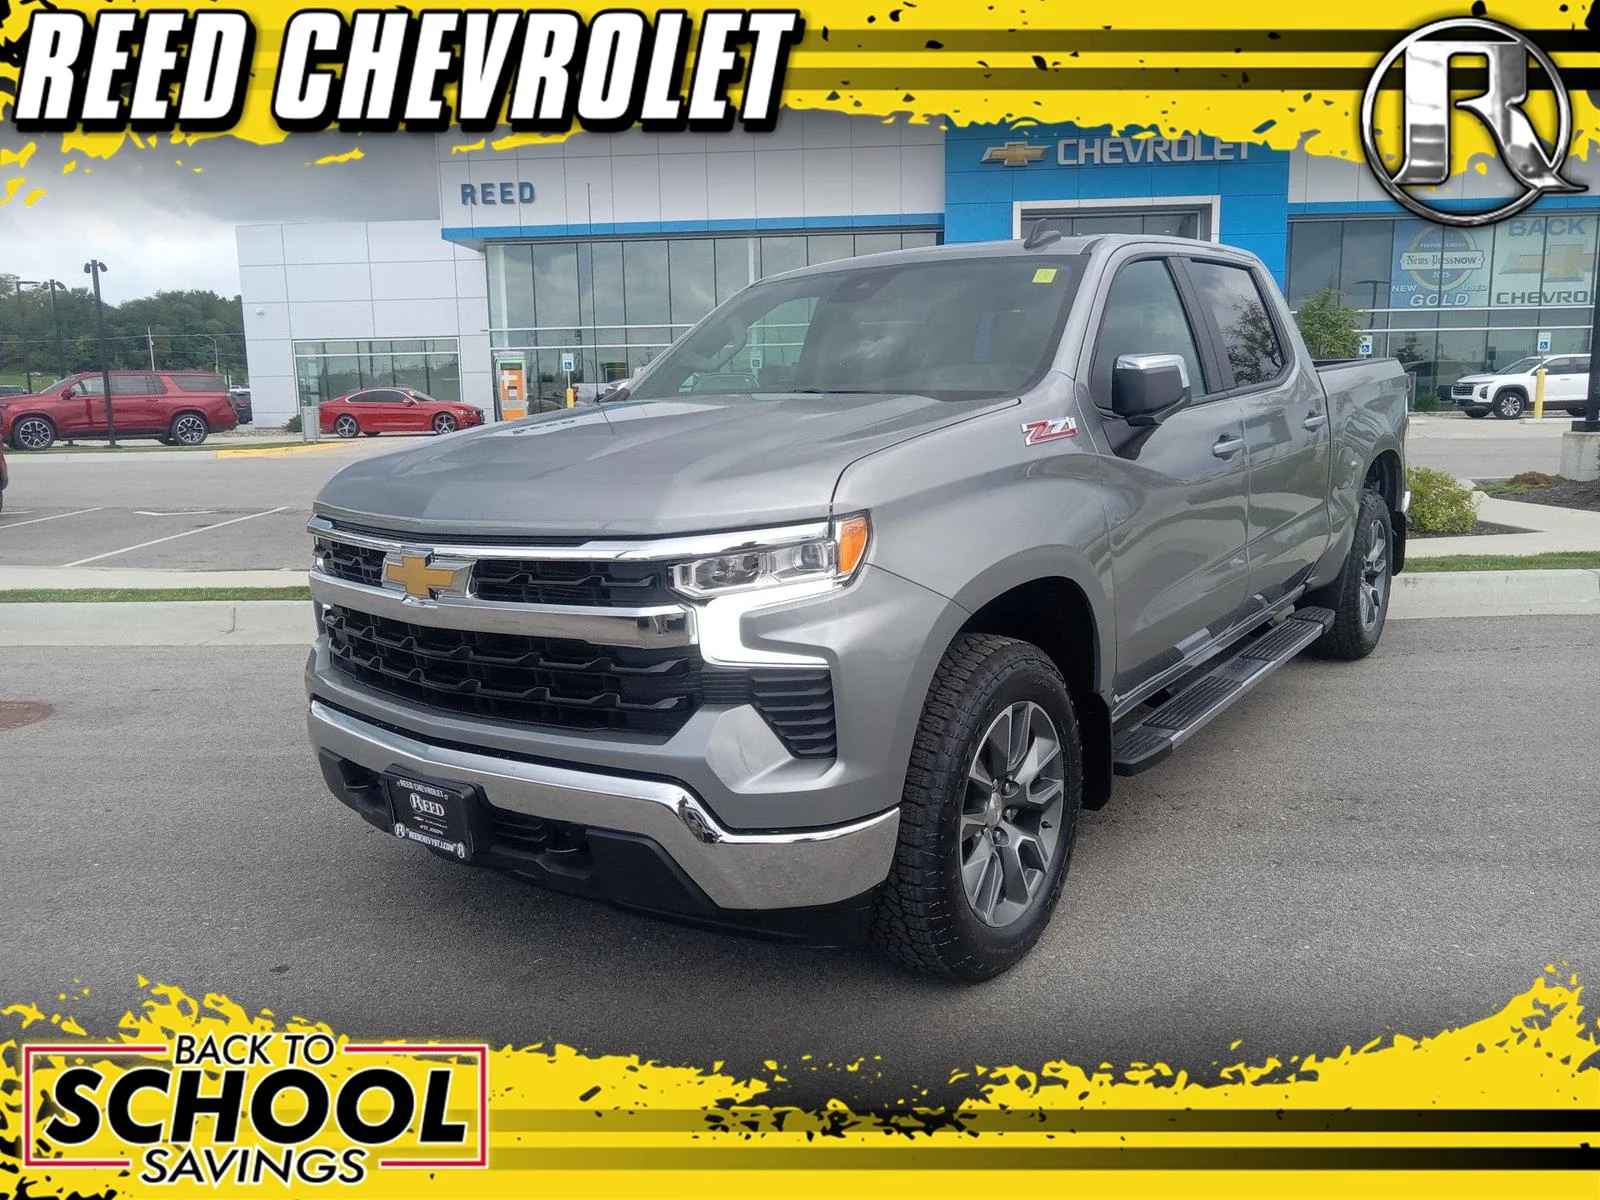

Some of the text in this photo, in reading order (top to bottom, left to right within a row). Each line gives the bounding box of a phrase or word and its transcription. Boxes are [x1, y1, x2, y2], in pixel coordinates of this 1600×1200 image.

[460, 181, 536, 206] REED
[1508, 217, 1586, 236] BACK
[1462, 284, 1488, 292] USED
[1496, 290, 1588, 304] CHEVRO
[1409, 293, 1470, 307] GOLD
[1020, 416, 1078, 446] Z71
[409, 792, 445, 817] REED
